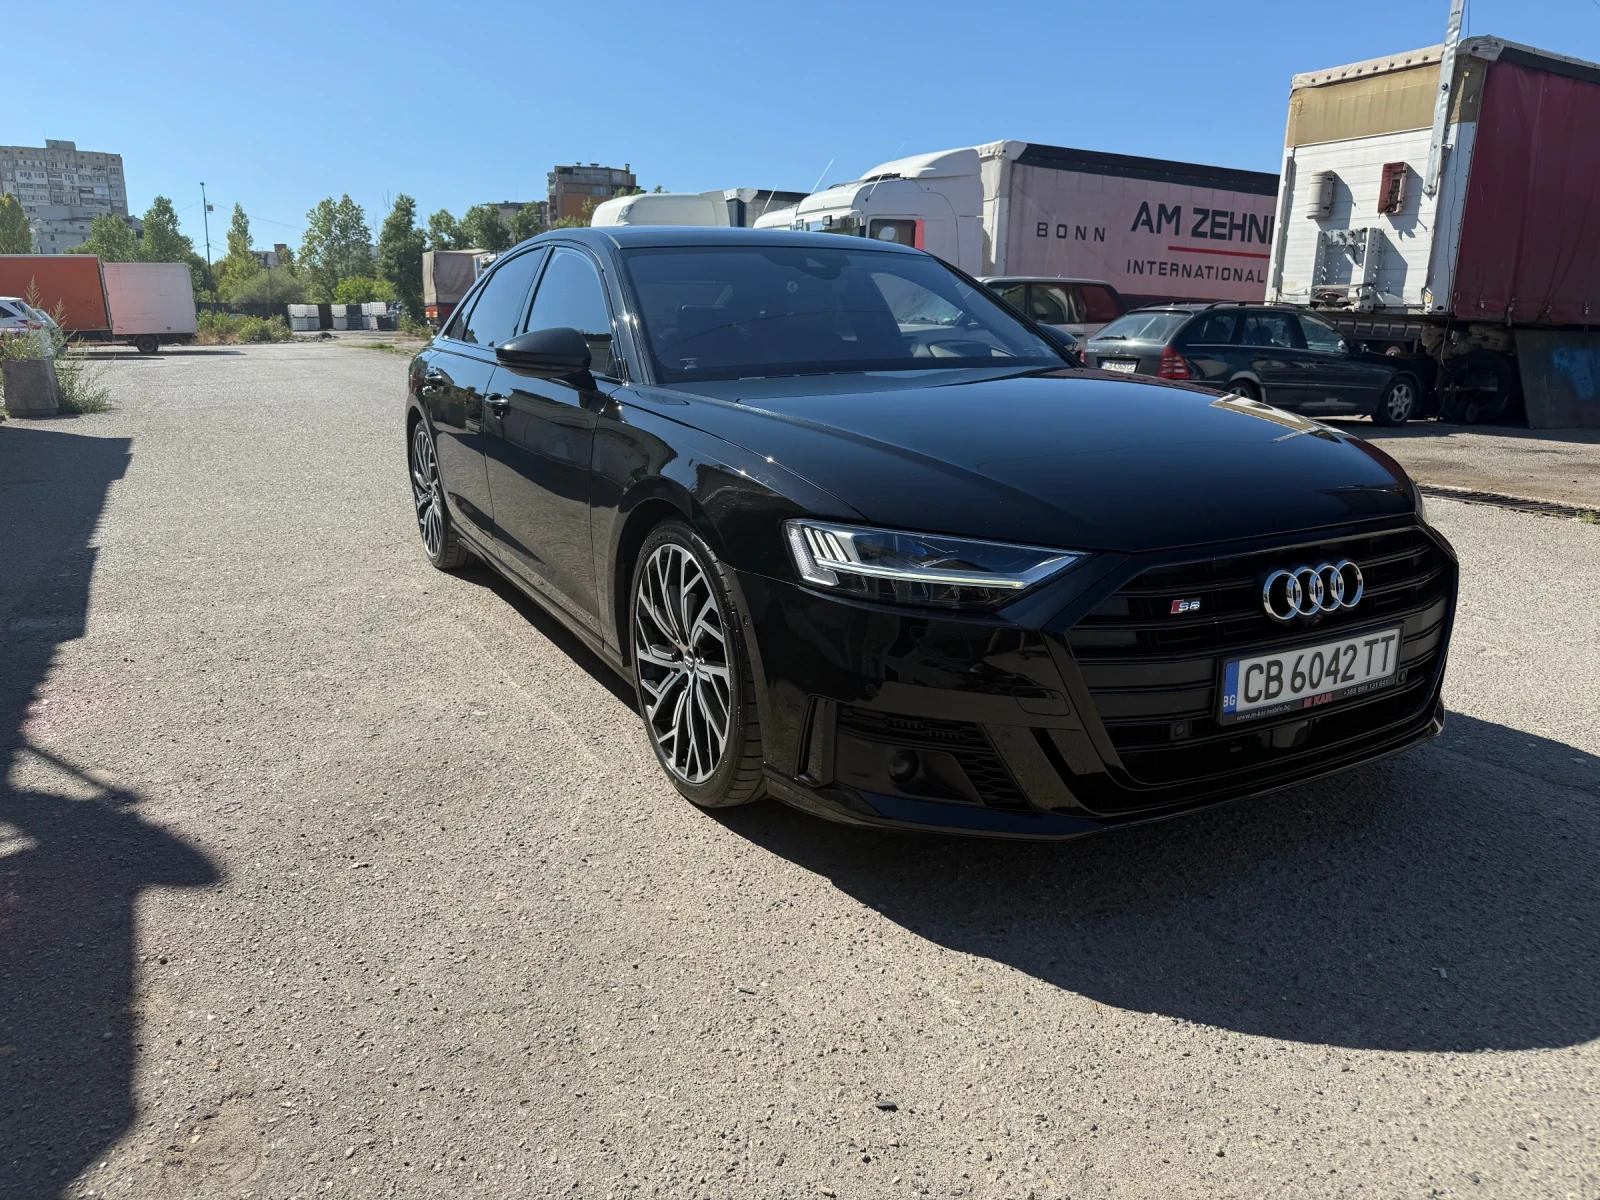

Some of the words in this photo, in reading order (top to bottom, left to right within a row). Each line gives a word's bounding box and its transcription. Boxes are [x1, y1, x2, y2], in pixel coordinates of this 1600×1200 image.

[1036, 221, 1106, 243] BONN
[1130, 200, 1182, 236] AM
[1191, 207, 1275, 245] ZEHN
[1126, 259, 1265, 284] INTERNATIONAL
[1243, 659, 1284, 704] CB
[1290, 643, 1358, 694] 6042
[1363, 634, 1396, 677] TT
[1223, 694, 1236, 708] BG
